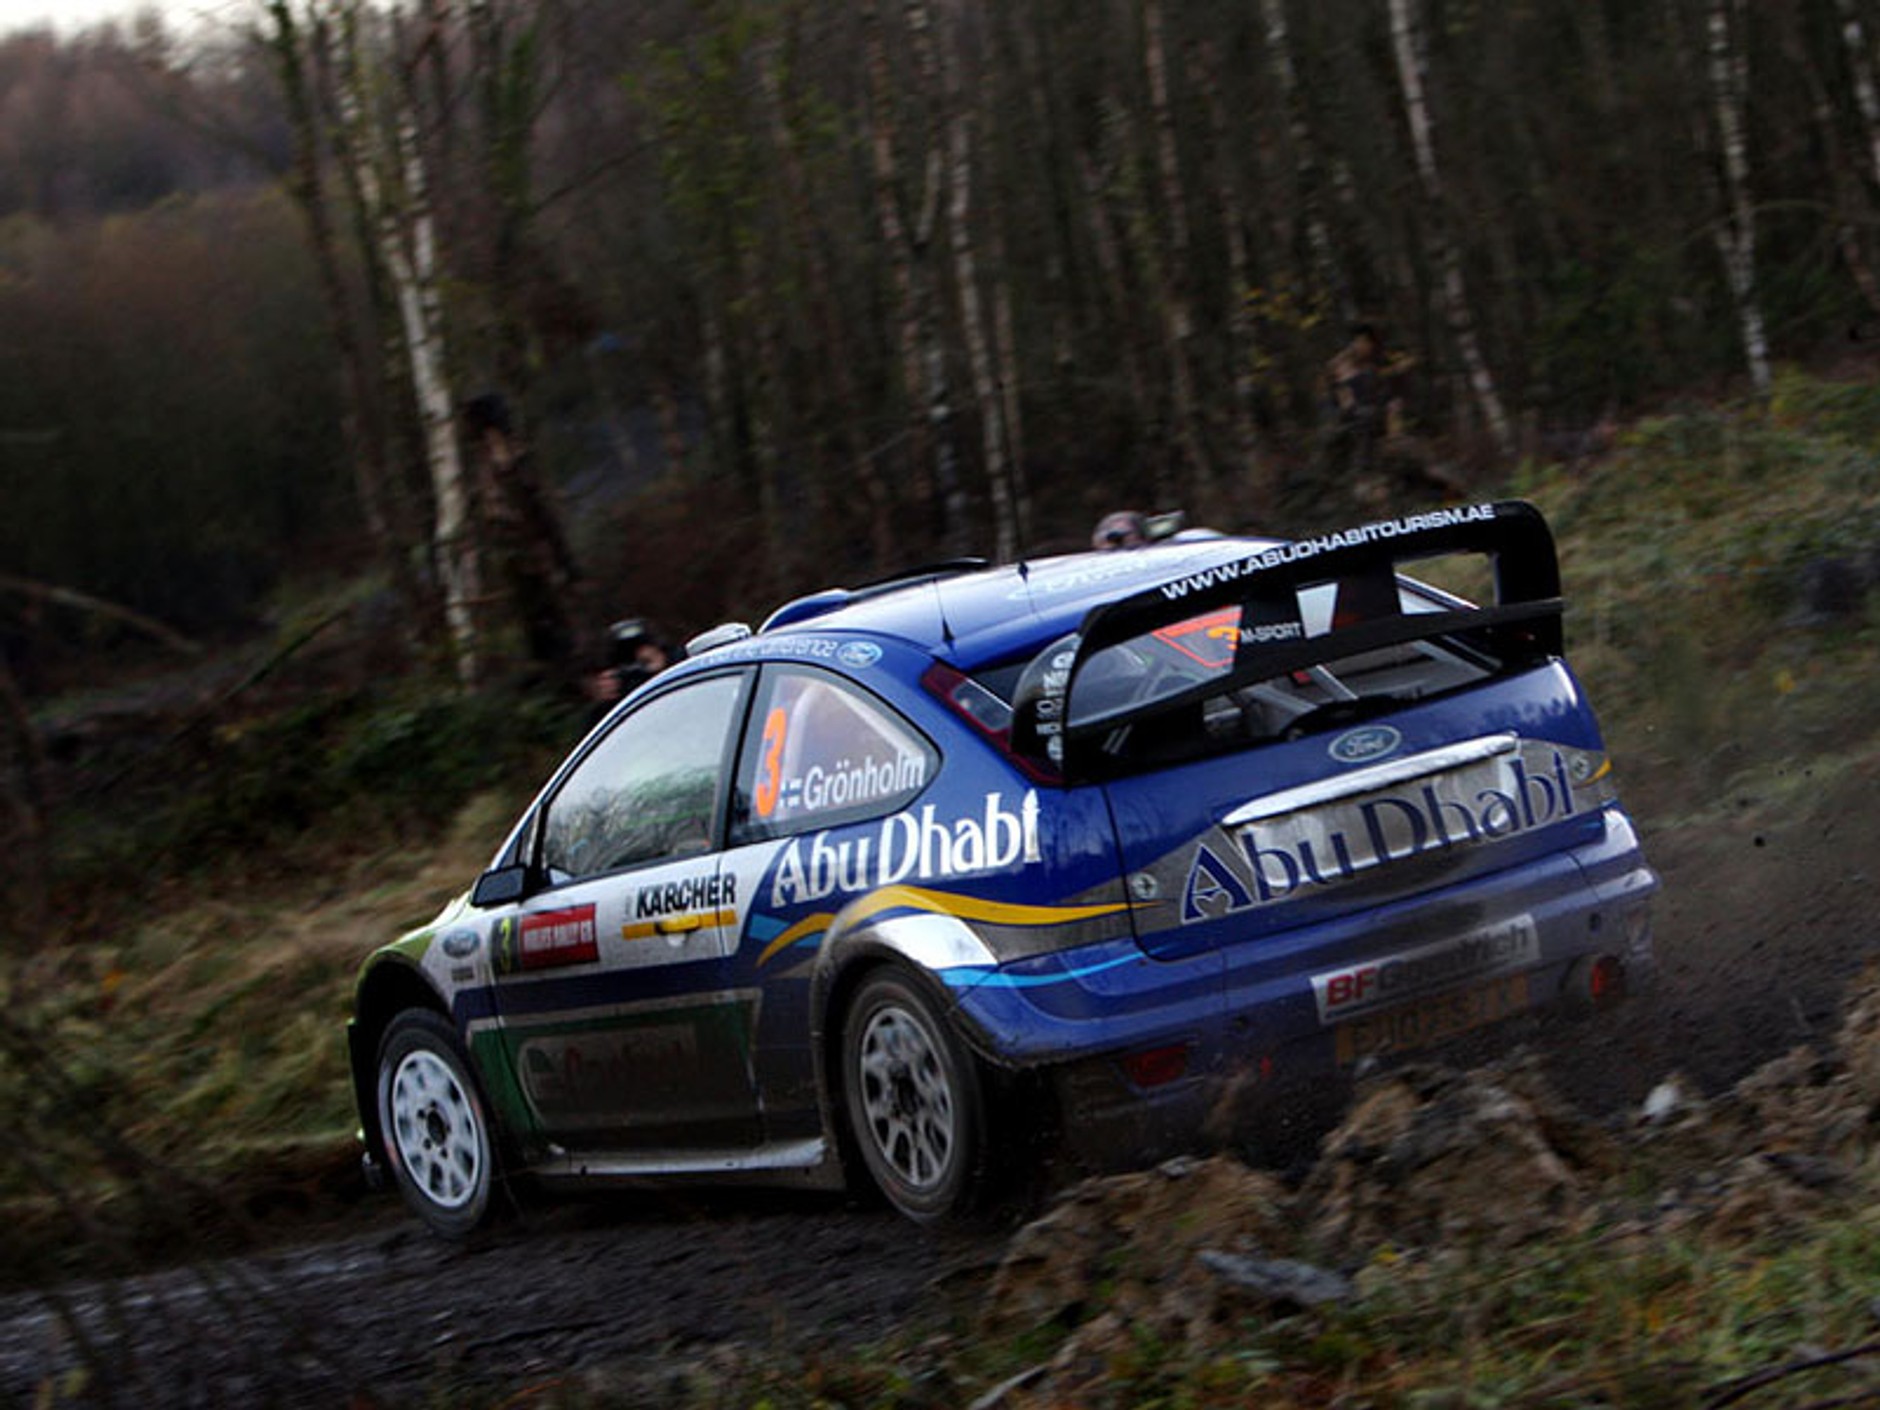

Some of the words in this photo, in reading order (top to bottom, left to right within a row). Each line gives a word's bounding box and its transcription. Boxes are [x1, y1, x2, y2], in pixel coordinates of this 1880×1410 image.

[1161, 503, 1496, 600] WWW.ABUDHABITOURISM.AE
[755, 706, 788, 817] 3
[803, 752, 926, 811] Grönholm
[774, 831, 870, 907] Abu
[877, 788, 1041, 887] Dhabi
[1181, 831, 1355, 925] Abu
[1359, 750, 1574, 862] Dhabi
